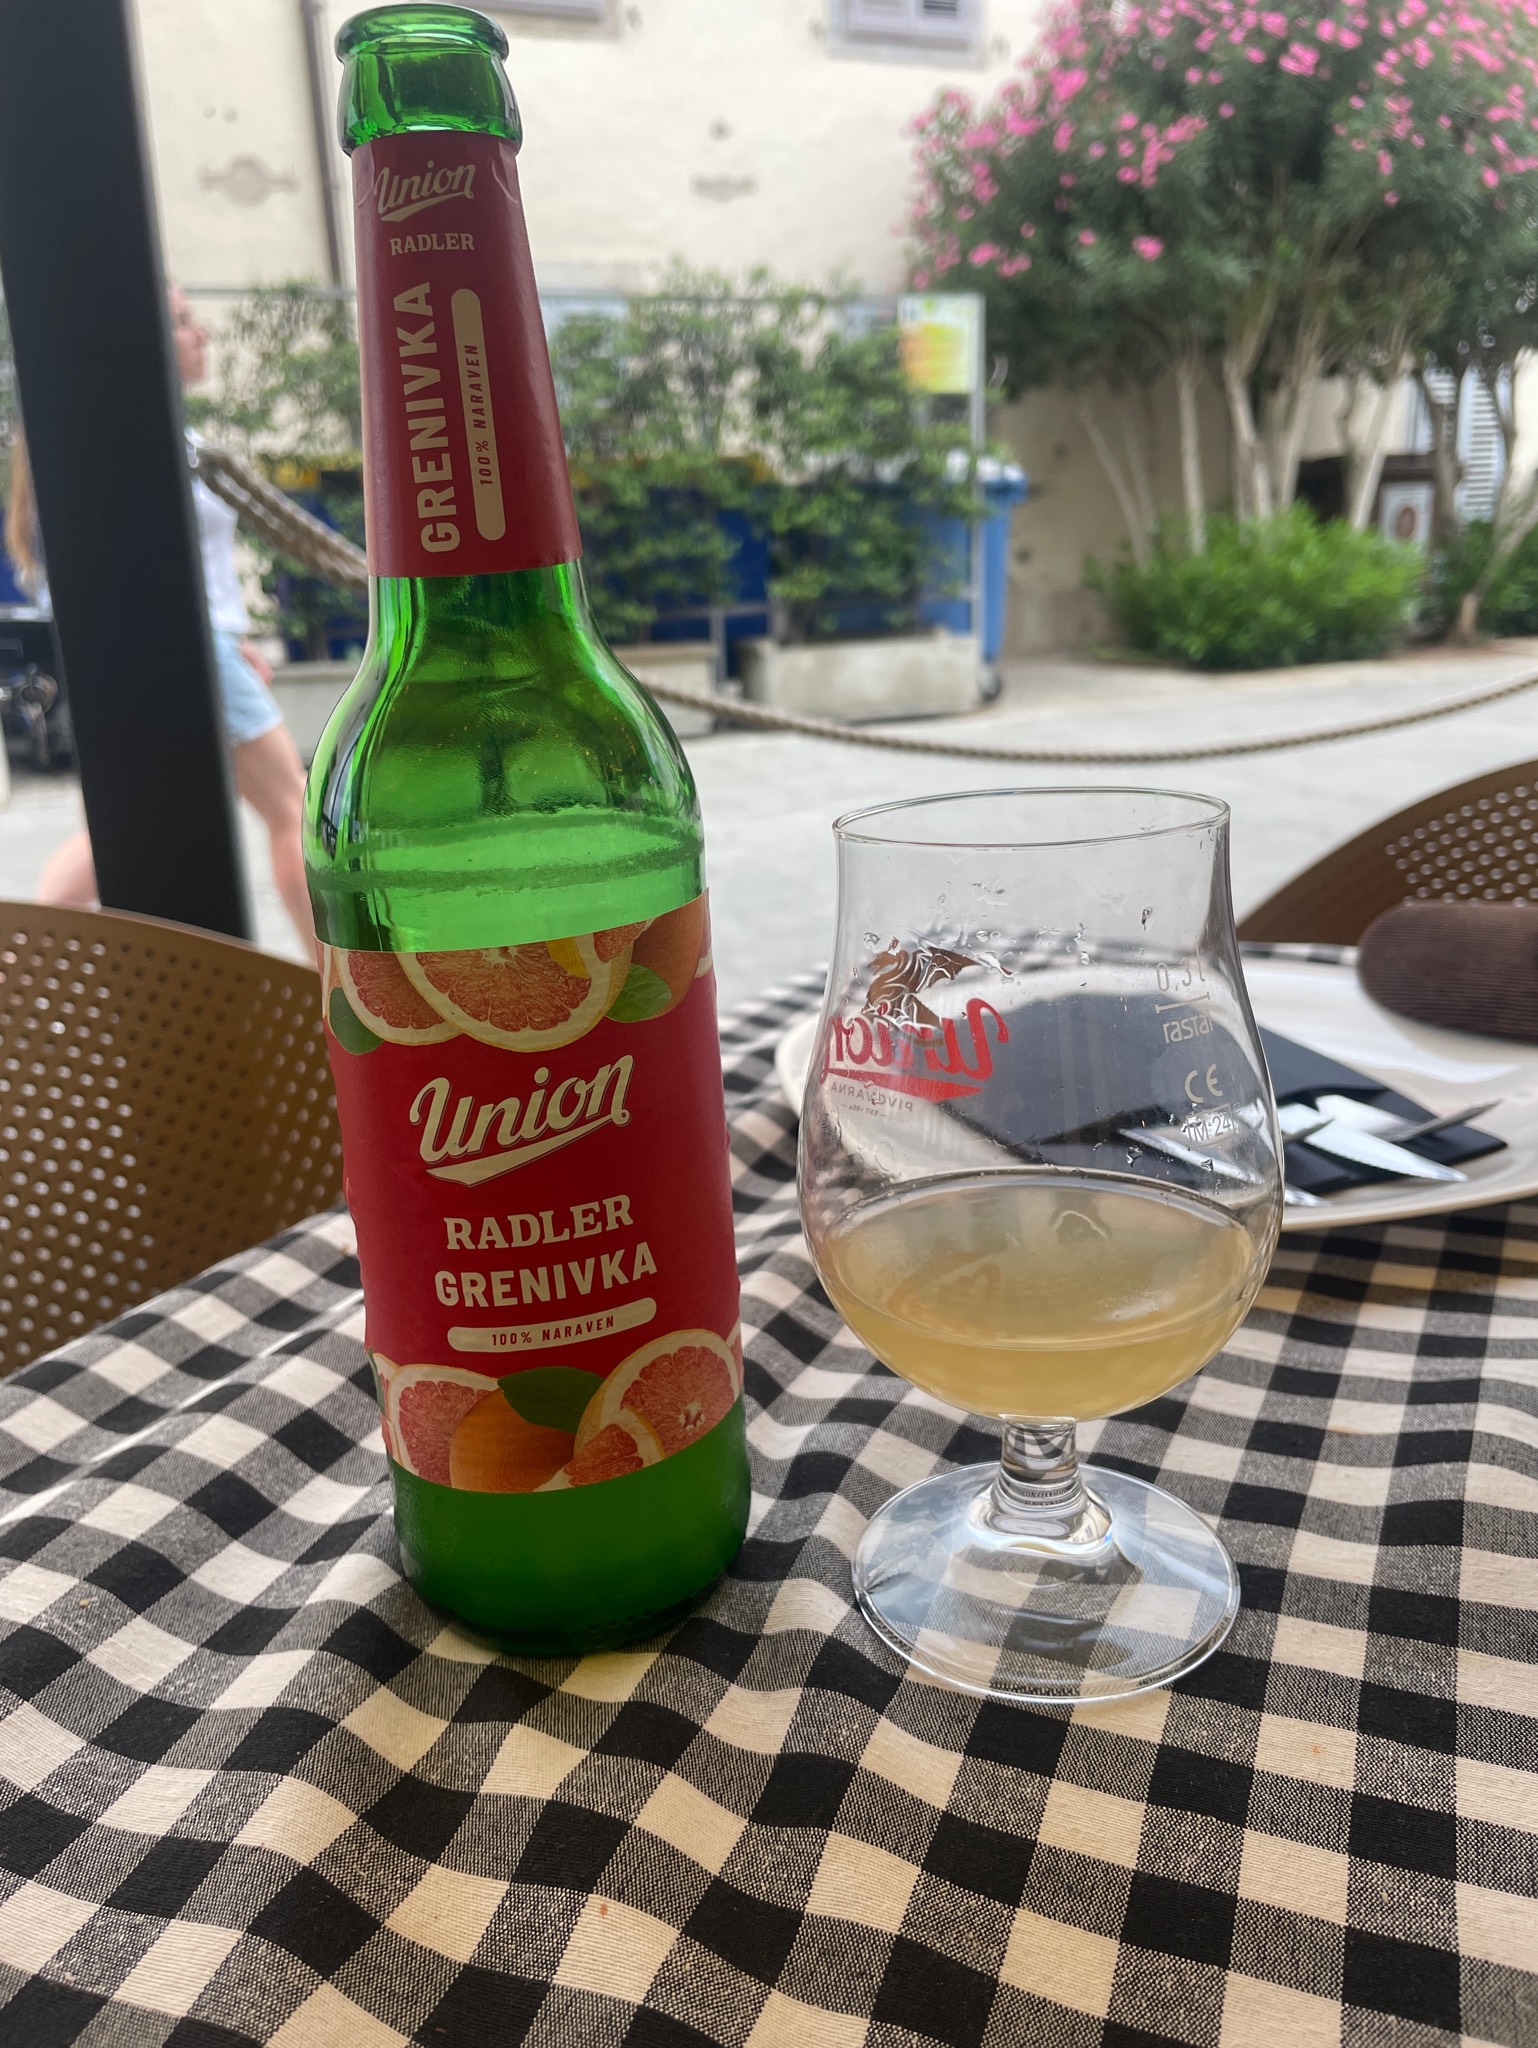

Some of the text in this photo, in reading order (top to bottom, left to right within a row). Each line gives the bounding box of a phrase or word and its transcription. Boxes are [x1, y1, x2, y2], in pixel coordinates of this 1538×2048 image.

[375, 159, 477, 223] Union
[389, 232, 475, 256] RADLER
[393, 281, 461, 553] GRENIVKA
[464, 344, 493, 486] 100% NARAVEN
[1162, 1008, 1214, 1044] rastal
[409, 1054, 634, 1188] Union
[443, 1194, 634, 1251] RADLER
[434, 1241, 658, 1308] GRENIVKA
[491, 1315, 616, 1347] 100% NARAVEN
